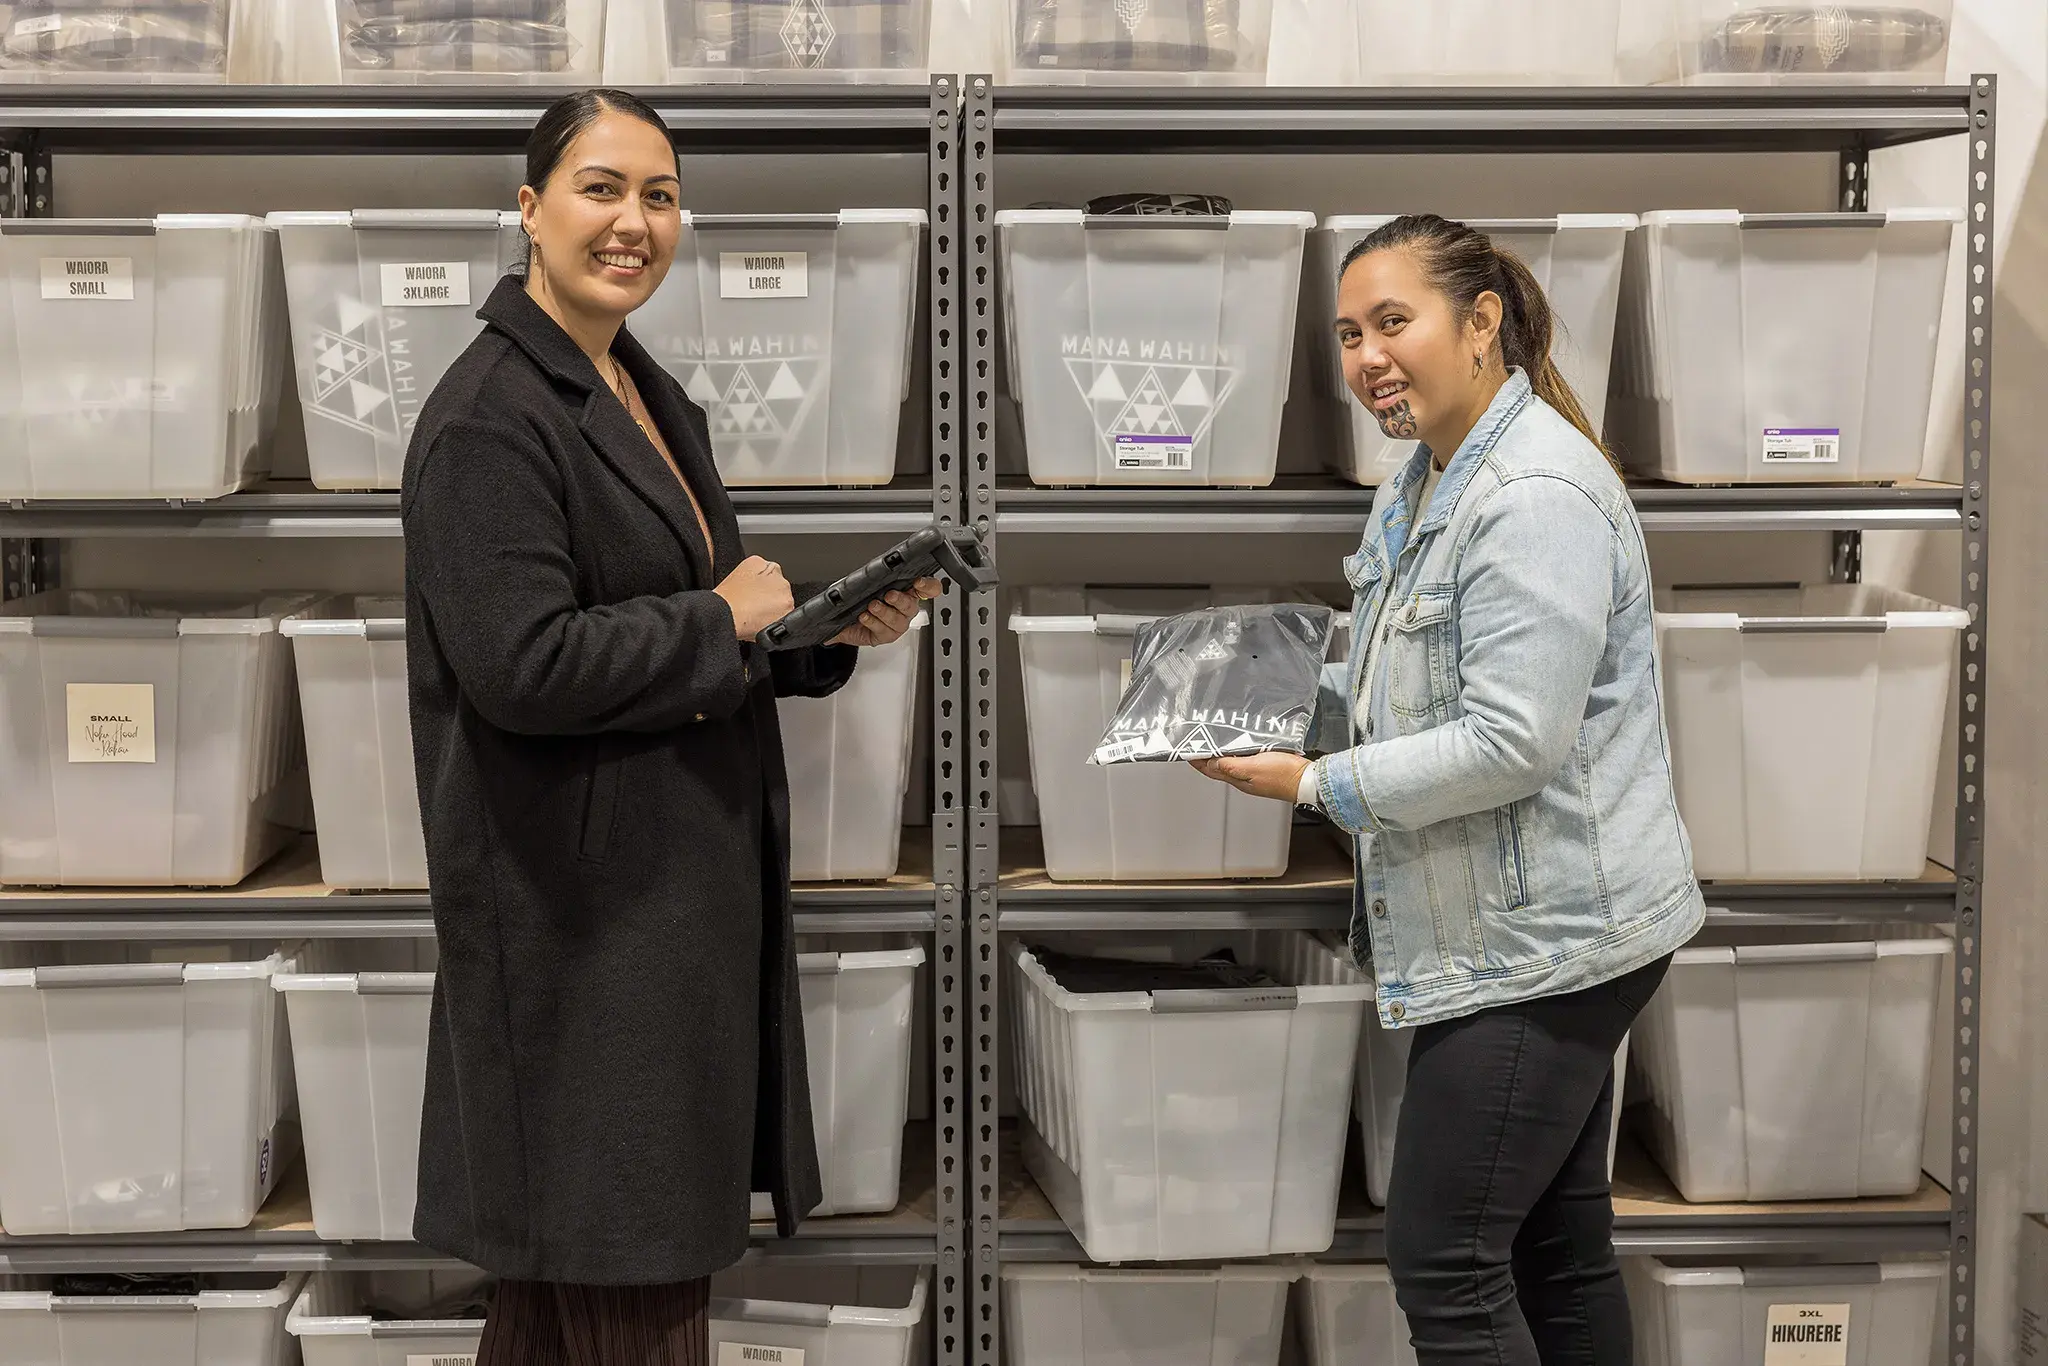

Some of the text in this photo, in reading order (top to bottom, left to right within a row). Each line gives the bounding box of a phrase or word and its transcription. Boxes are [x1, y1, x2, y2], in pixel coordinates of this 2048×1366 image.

[65, 261, 109, 274] WAIORA
[744, 257, 785, 270] WAIORA
[405, 266, 446, 280] WAIORA
[69, 281, 107, 295] SMALL
[749, 276, 781, 290] LARGE
[403, 286, 450, 299] 3XLARGE
[1062, 334, 1130, 357] MANA
[1191, 709, 1306, 736] WAHINE
[1771, 1324, 1842, 1342] HIKURERE
[742, 1347, 782, 1362] WAIORA
